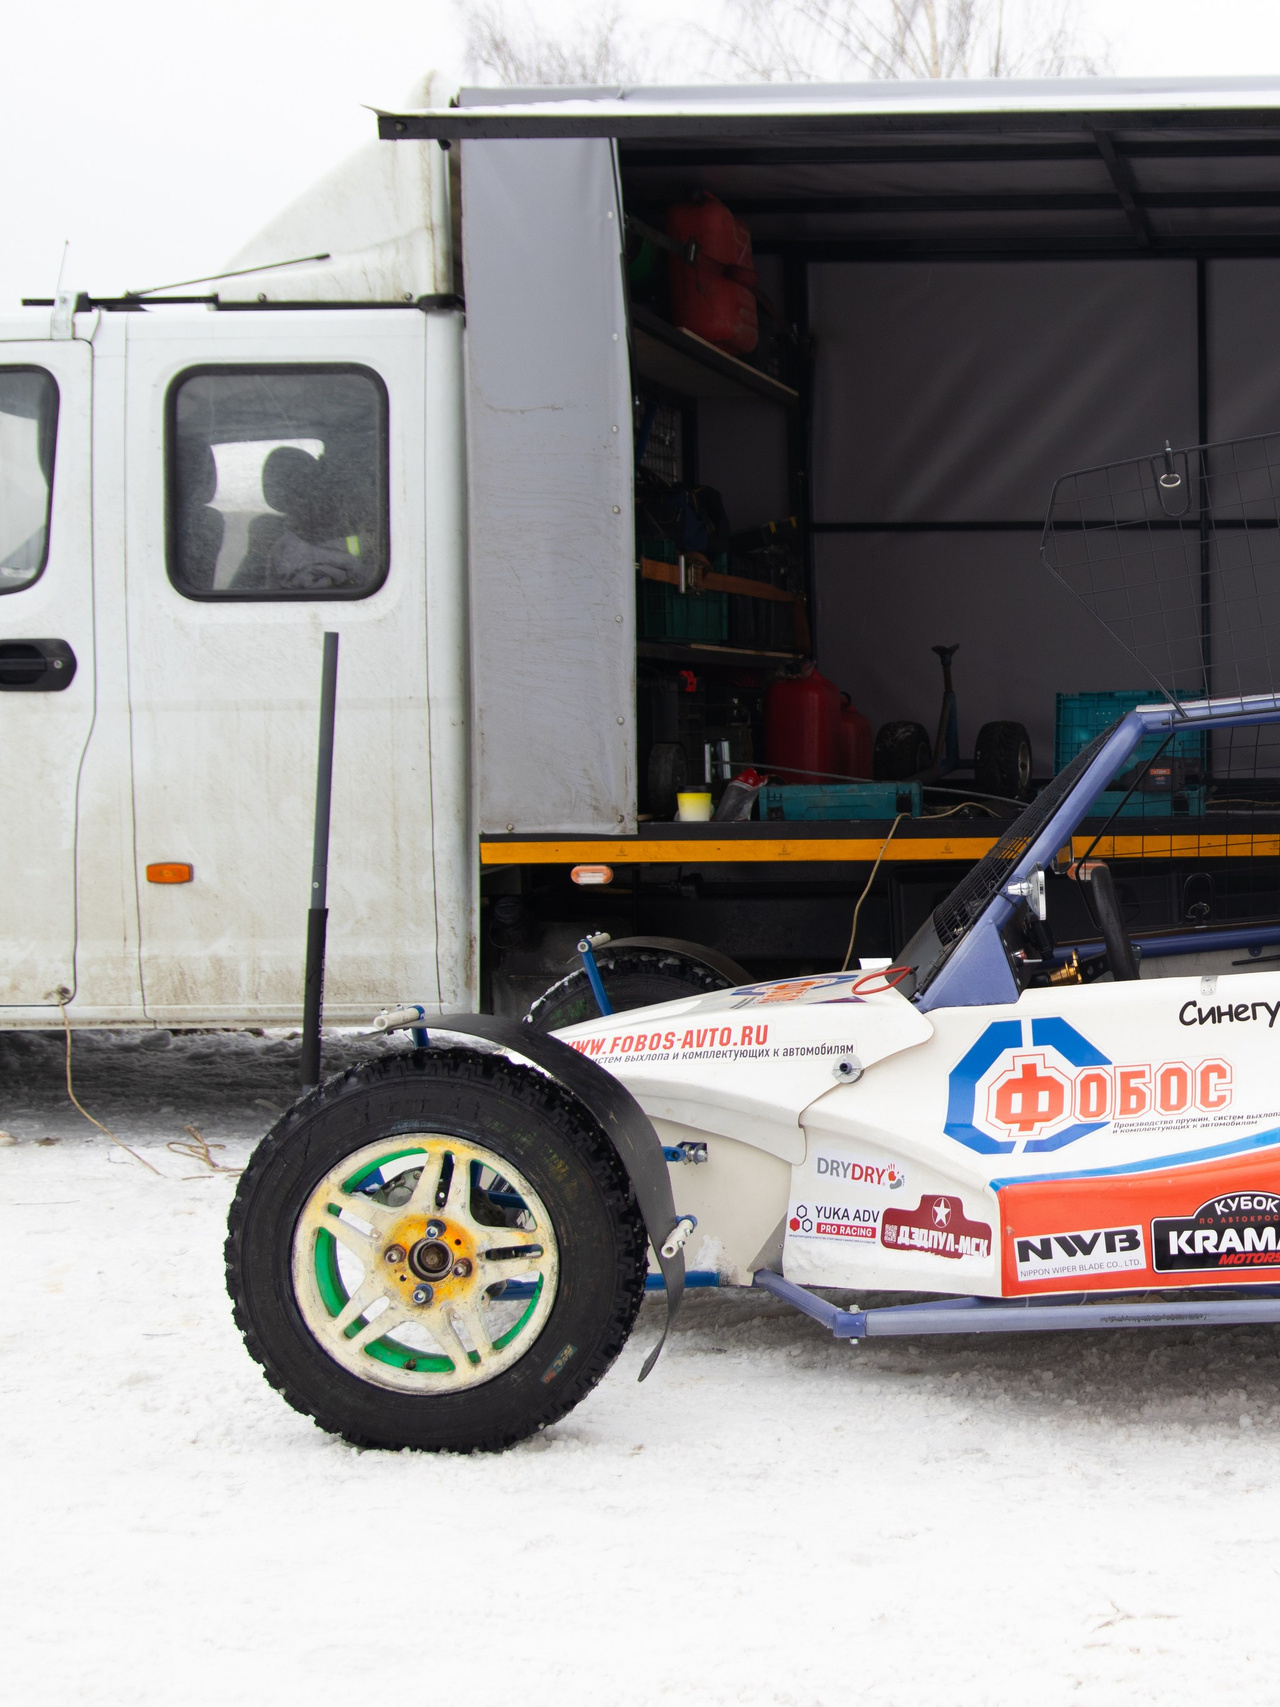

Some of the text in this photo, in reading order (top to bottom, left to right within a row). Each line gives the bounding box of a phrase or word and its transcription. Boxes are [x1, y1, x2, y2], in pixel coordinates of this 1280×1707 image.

[624, 1052, 669, 1063] выхлопа
[672, 1052, 680, 1061] и
[682, 1047, 770, 1062] комплектующих
[773, 1048, 780, 1057] к
[783, 1043, 854, 1057] автомобилям
[987, 1055, 1233, 1136] ФОБОС
[1113, 1119, 1174, 1129] Производство
[1213, 1114, 1244, 1122] систем
[815, 1205, 880, 1223] YUKA ADV
[1214, 1195, 1280, 1216] КУБОК
[820, 1224, 873, 1237] PRO RACING
[1199, 1217, 1214, 1225] ПО
[1016, 1229, 1141, 1263] NWB
[1020, 1267, 1050, 1278] NIPPON
[1051, 1265, 1077, 1275] WIPER
[1079, 1262, 1105, 1273] BLADE
[1124, 1258, 1142, 1267] LTD.
